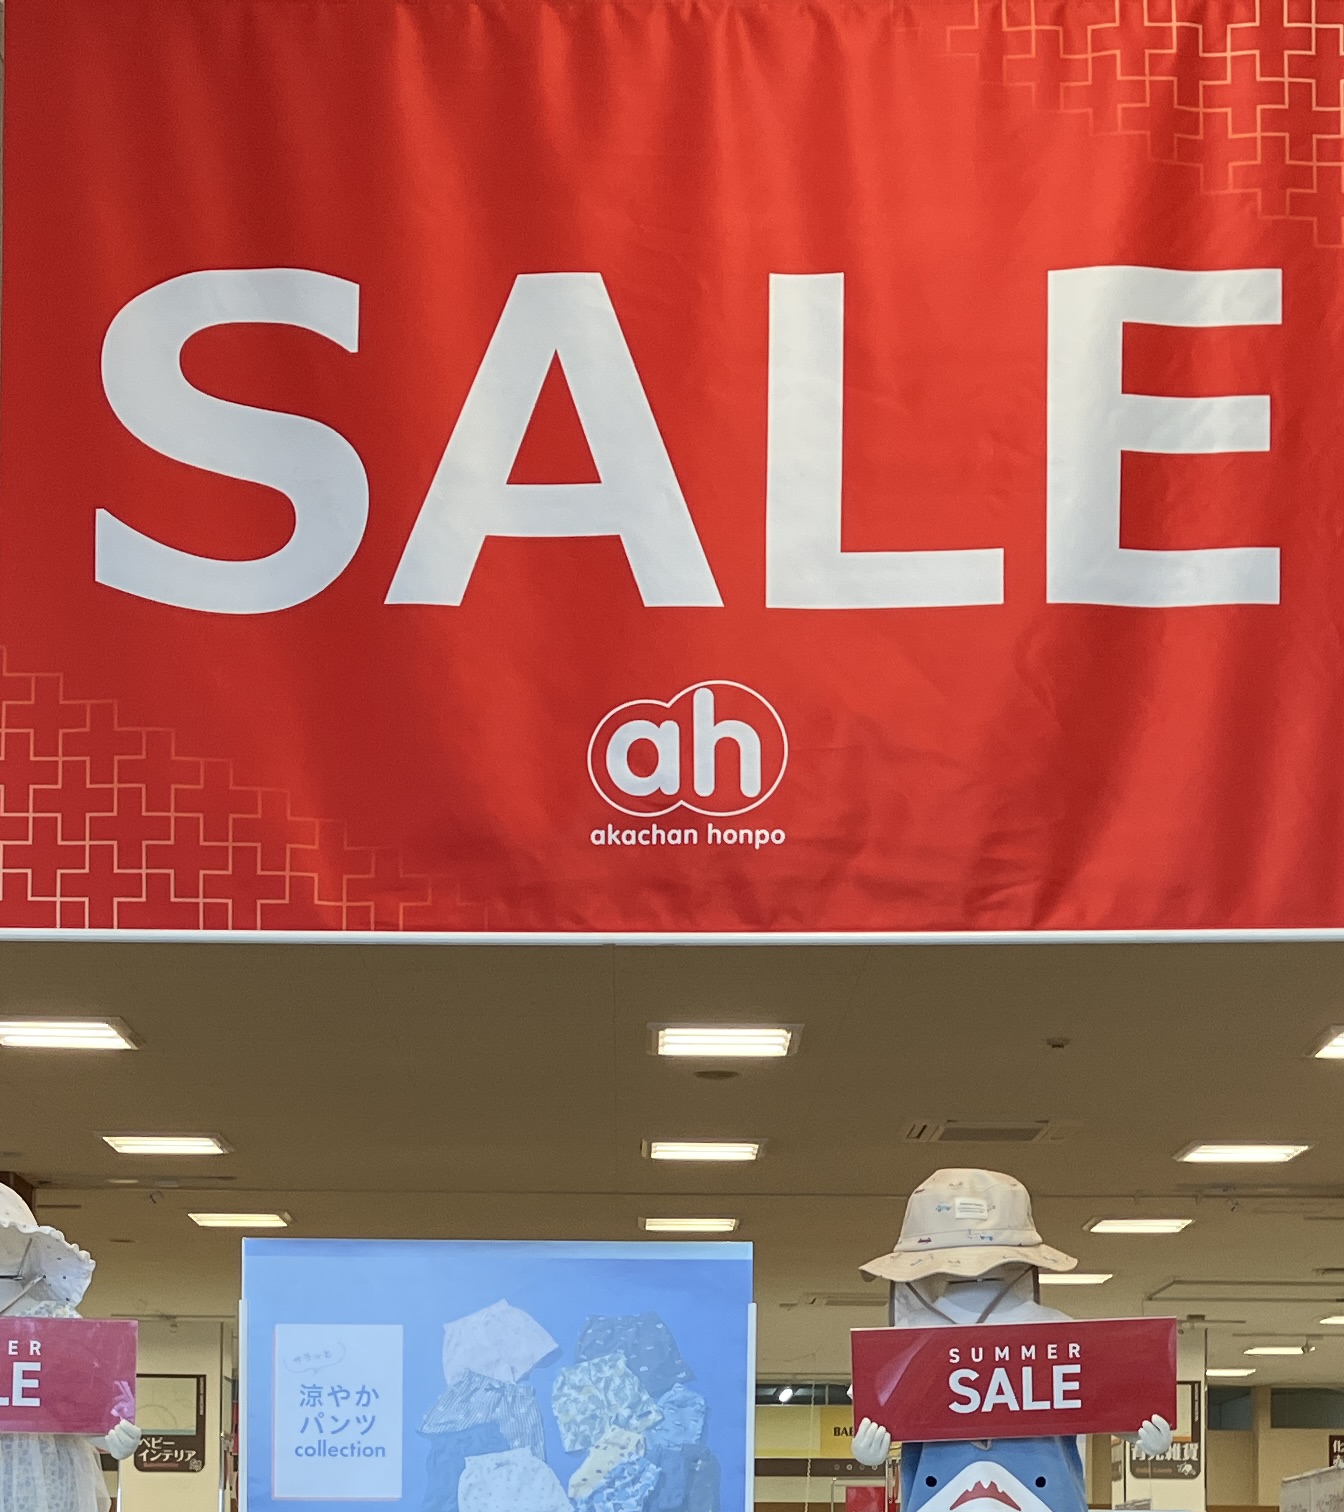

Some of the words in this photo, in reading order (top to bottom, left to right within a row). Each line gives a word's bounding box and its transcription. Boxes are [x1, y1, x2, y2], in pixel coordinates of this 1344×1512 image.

[94, 266, 1283, 615] SALE
[606, 687, 762, 798] ah
[590, 823, 698, 846] akachan
[707, 822, 786, 850] honpo
[948, 1343, 1081, 1364] SUMMER
[300, 1384, 379, 1408] 涼やか
[948, 1364, 1082, 1414] SALE
[300, 1412, 376, 1436] パンツ
[140, 1436, 175, 1450] ベビー
[294, 1440, 386, 1458] collection
[137, 1449, 197, 1462] インテリア
